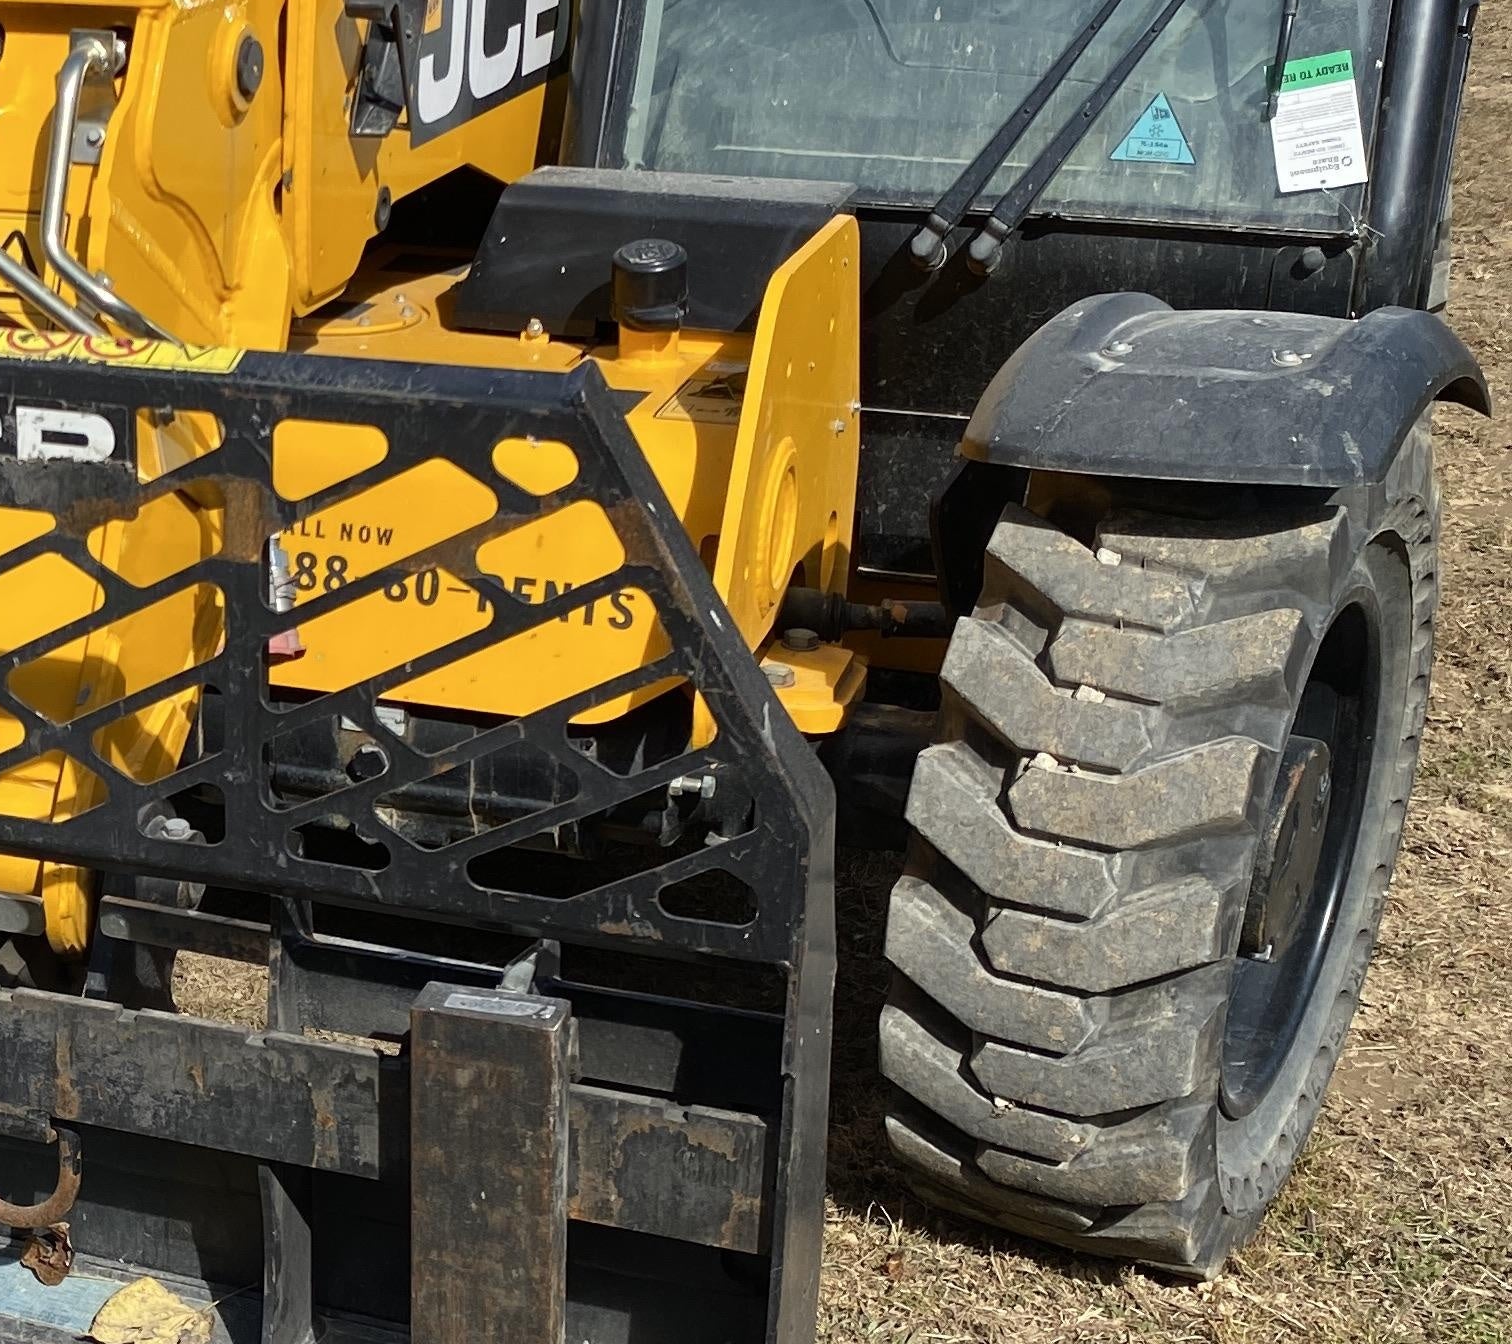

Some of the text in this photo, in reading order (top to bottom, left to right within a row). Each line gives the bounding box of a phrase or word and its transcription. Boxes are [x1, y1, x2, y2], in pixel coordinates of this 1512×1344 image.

[1283, 62, 1350, 84] READY TO RE
[1290, 163, 1340, 177] Equipment
[340, 522, 394, 546] NOW
